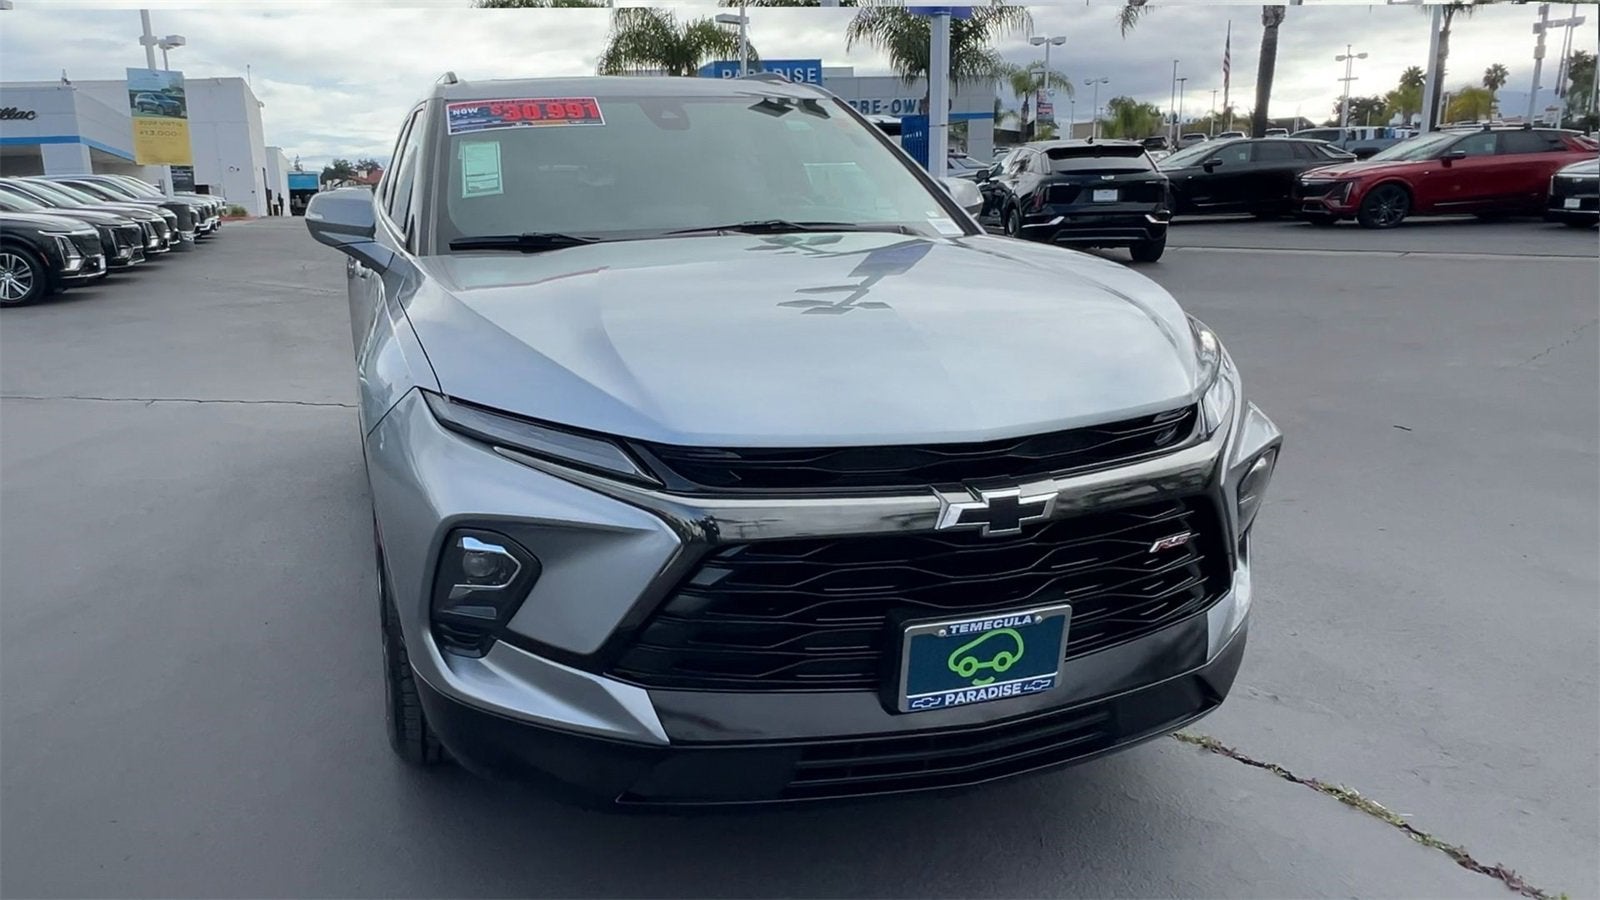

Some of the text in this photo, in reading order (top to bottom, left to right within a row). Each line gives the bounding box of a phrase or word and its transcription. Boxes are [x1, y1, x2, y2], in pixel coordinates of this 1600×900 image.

[721, 67, 817, 83] PARDISE
[452, 107, 479, 116] NOW
[847, 98, 953, 114] PRE-OW
[949, 614, 1032, 634] TEMECULA
[944, 683, 1022, 706] PARADISE
